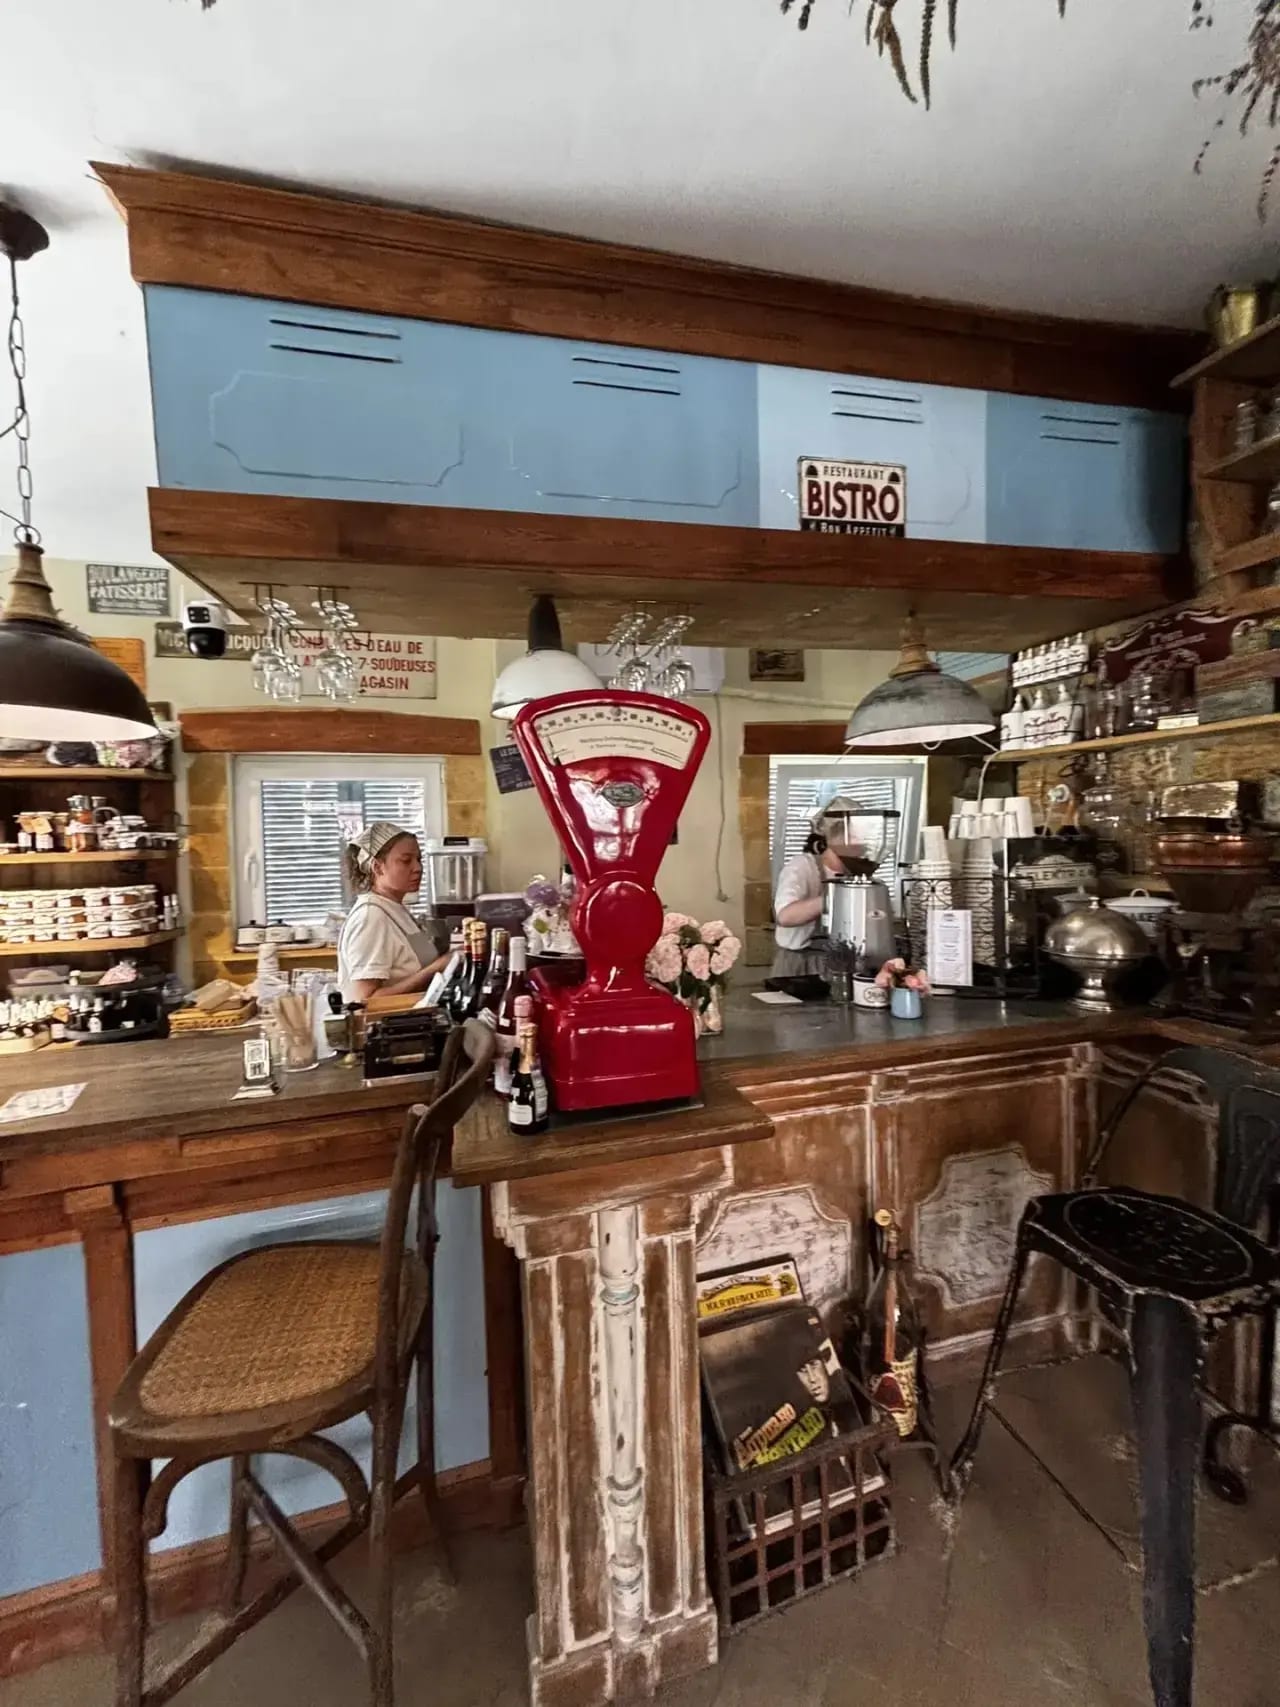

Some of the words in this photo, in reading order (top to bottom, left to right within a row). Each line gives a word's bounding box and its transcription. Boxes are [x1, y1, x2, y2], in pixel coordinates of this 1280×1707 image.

[823, 466, 885, 480] RESTAURANT
[807, 479, 900, 522] BISTRO
[407, 641, 424, 654] DE
